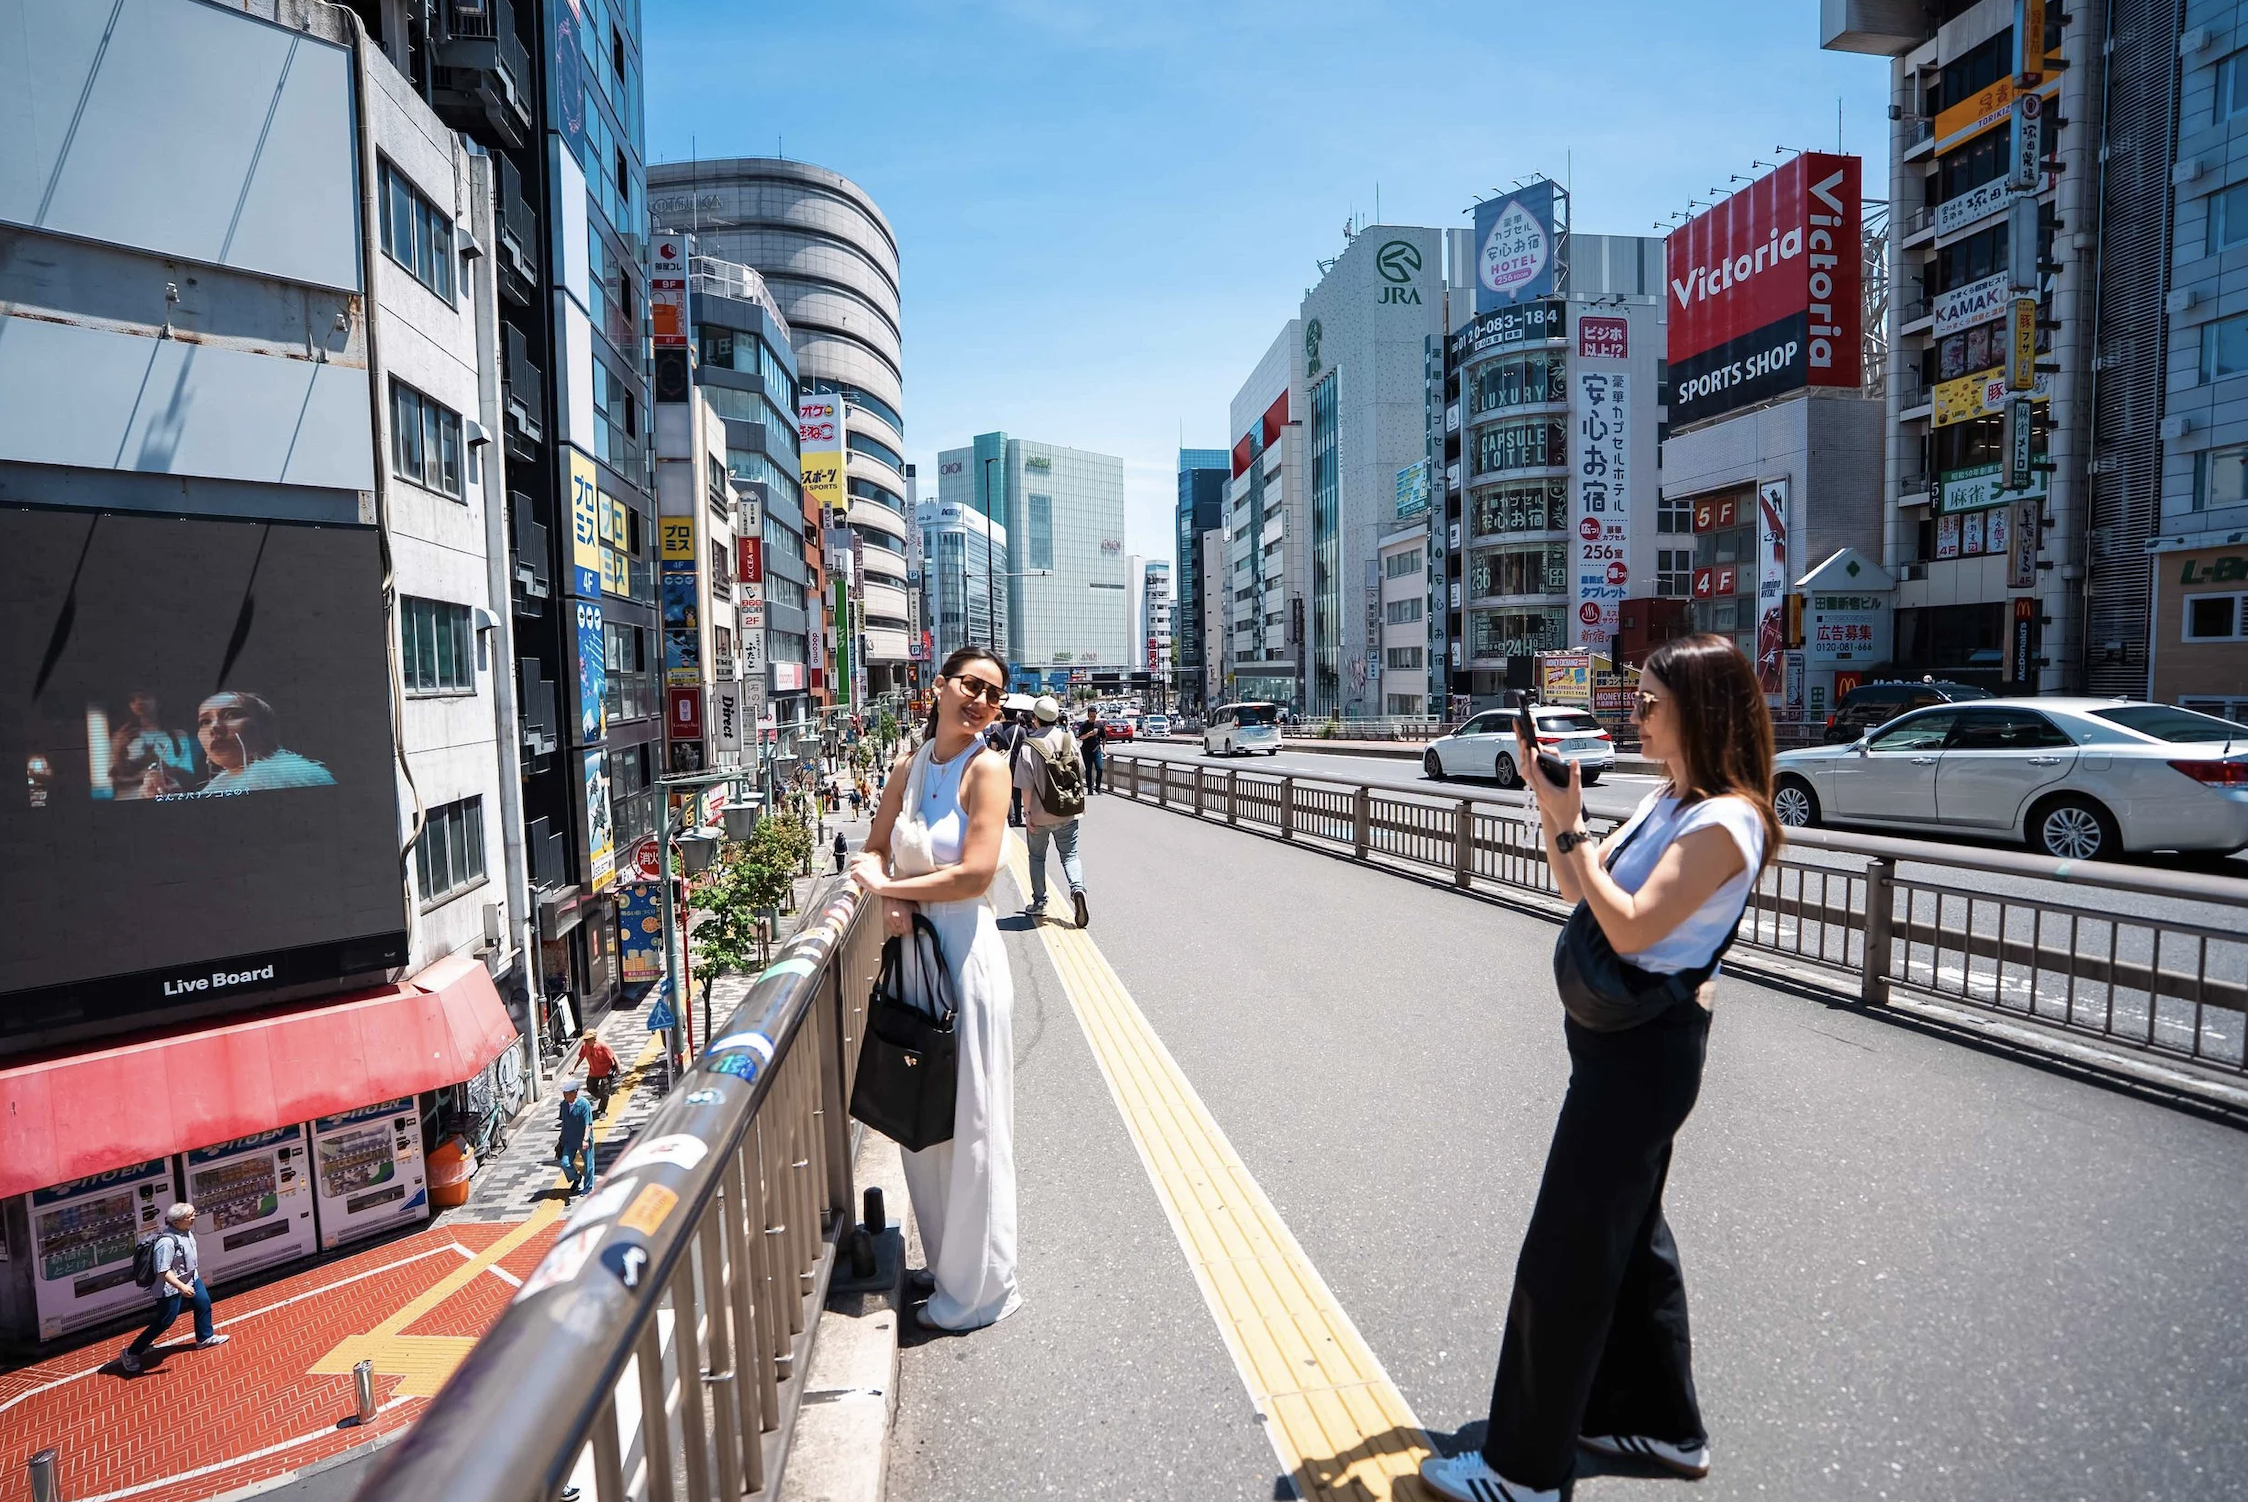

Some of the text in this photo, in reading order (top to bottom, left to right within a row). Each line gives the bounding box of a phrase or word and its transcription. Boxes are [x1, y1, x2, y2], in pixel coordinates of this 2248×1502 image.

[1494, 221, 1533, 242] カプセル
[1487, 233, 1541, 261] 安心お宿
[1490, 253, 1538, 275] HOTEL
[1671, 227, 1802, 310] Victoria
[1809, 169, 1845, 367] Victoria
[662, 280, 676, 288] 9F
[1377, 287, 1422, 304] JRA
[1458, 309, 1558, 350] 0120-083-184
[1584, 326, 1623, 342] ビジホ
[1584, 342, 1624, 358] 以上!?
[1679, 341, 1798, 404] SPORTS SHOP
[1481, 384, 1545, 411] LUXURY
[1481, 428, 1546, 453] CAPSULE
[1582, 374, 1608, 513] 安心お宿
[1612, 375, 1625, 513] 豪華カプセルホテル
[2016, 403, 2029, 469] 麻雀メトロ
[1481, 446, 1546, 472] HOTEL
[574, 475, 594, 513] プロ
[1950, 484, 1985, 508] 麻雀
[576, 512, 596, 548] ミス
[664, 525, 690, 537] プロ
[665, 539, 690, 551] ミス
[1939, 545, 1957, 555] 4F
[583, 571, 593, 592] 4F
[2019, 577, 2031, 585] 4F
[1581, 587, 1627, 599] タブレット
[745, 616, 760, 625] 2F
[836, 625, 845, 648] レイク
[1817, 625, 1872, 641] 広告募集
[1816, 643, 1872, 652] 0120-081-666
[2018, 621, 2028, 682] McDonald's
[1596, 692, 1621, 700] MONEY
[722, 694, 735, 739] Direct
[163, 964, 274, 997] Live Board
